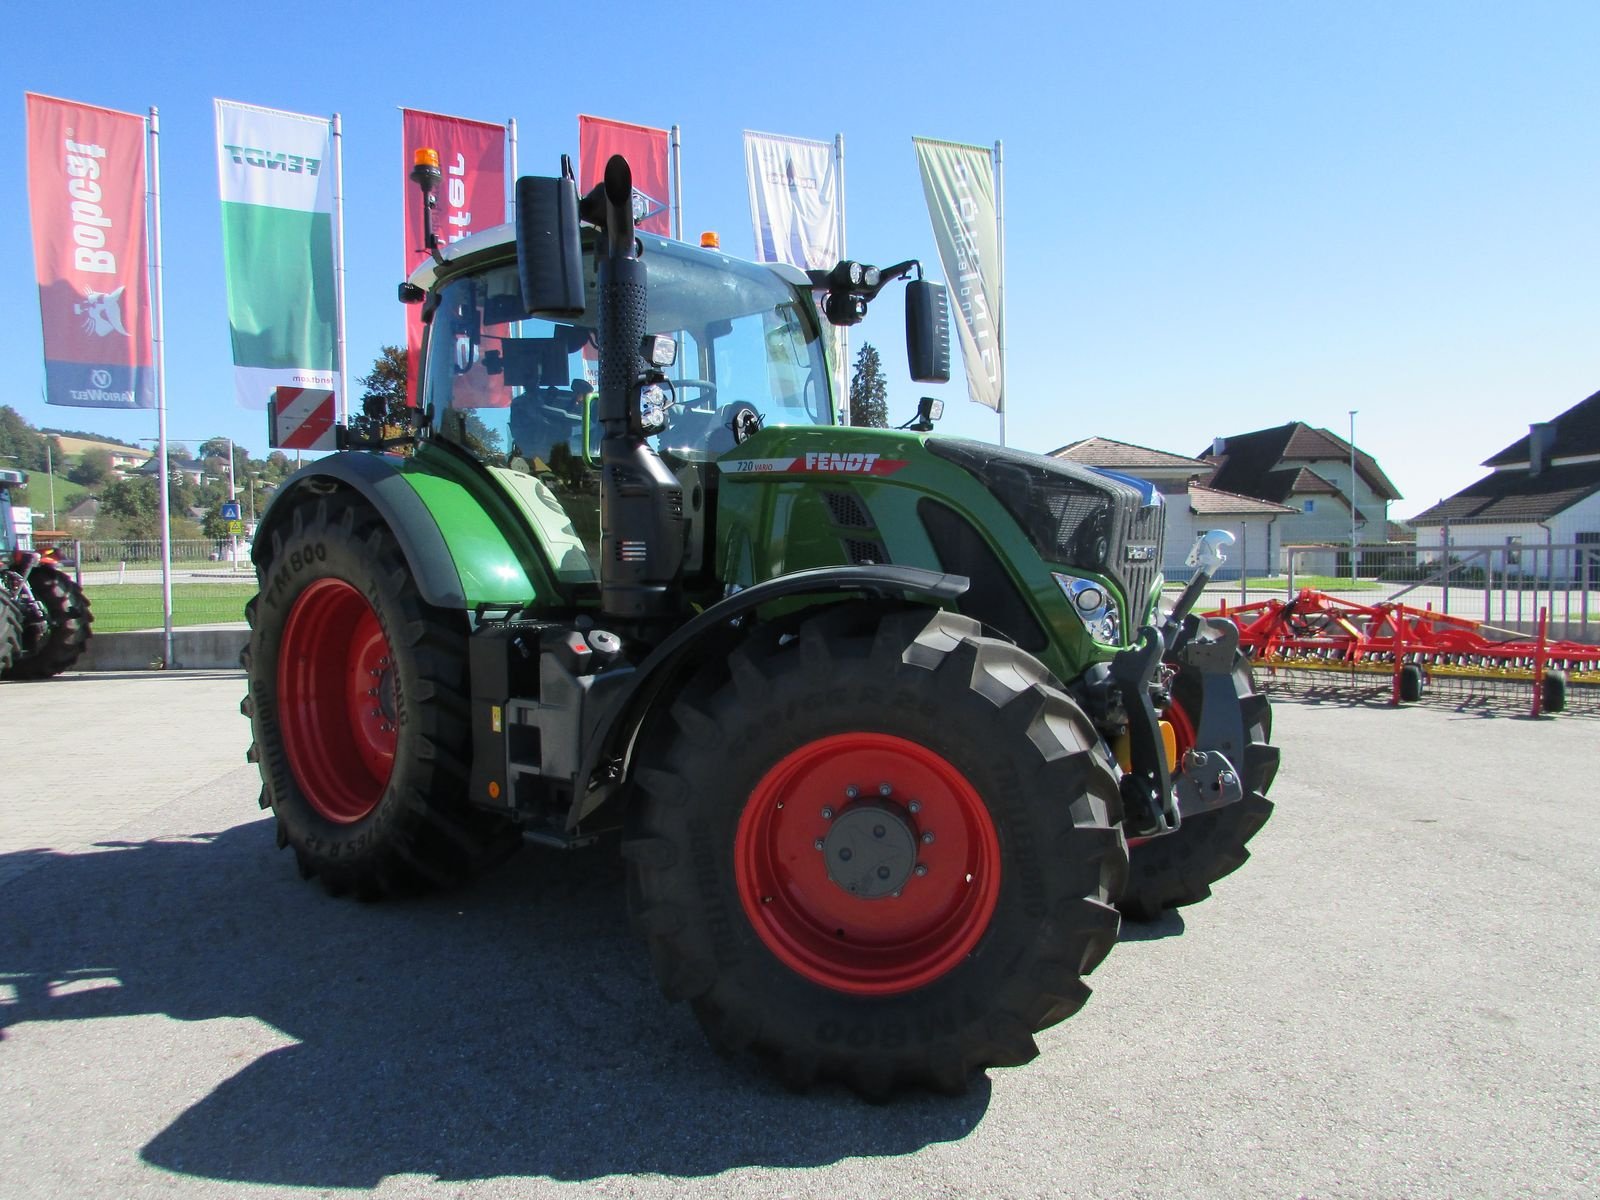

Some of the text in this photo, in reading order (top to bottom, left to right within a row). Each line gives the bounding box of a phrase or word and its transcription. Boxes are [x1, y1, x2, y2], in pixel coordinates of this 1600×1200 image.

[737, 461, 773, 471] 720 VARIO
[805, 452, 881, 472] FENDT
[265, 543, 327, 610] TM800
